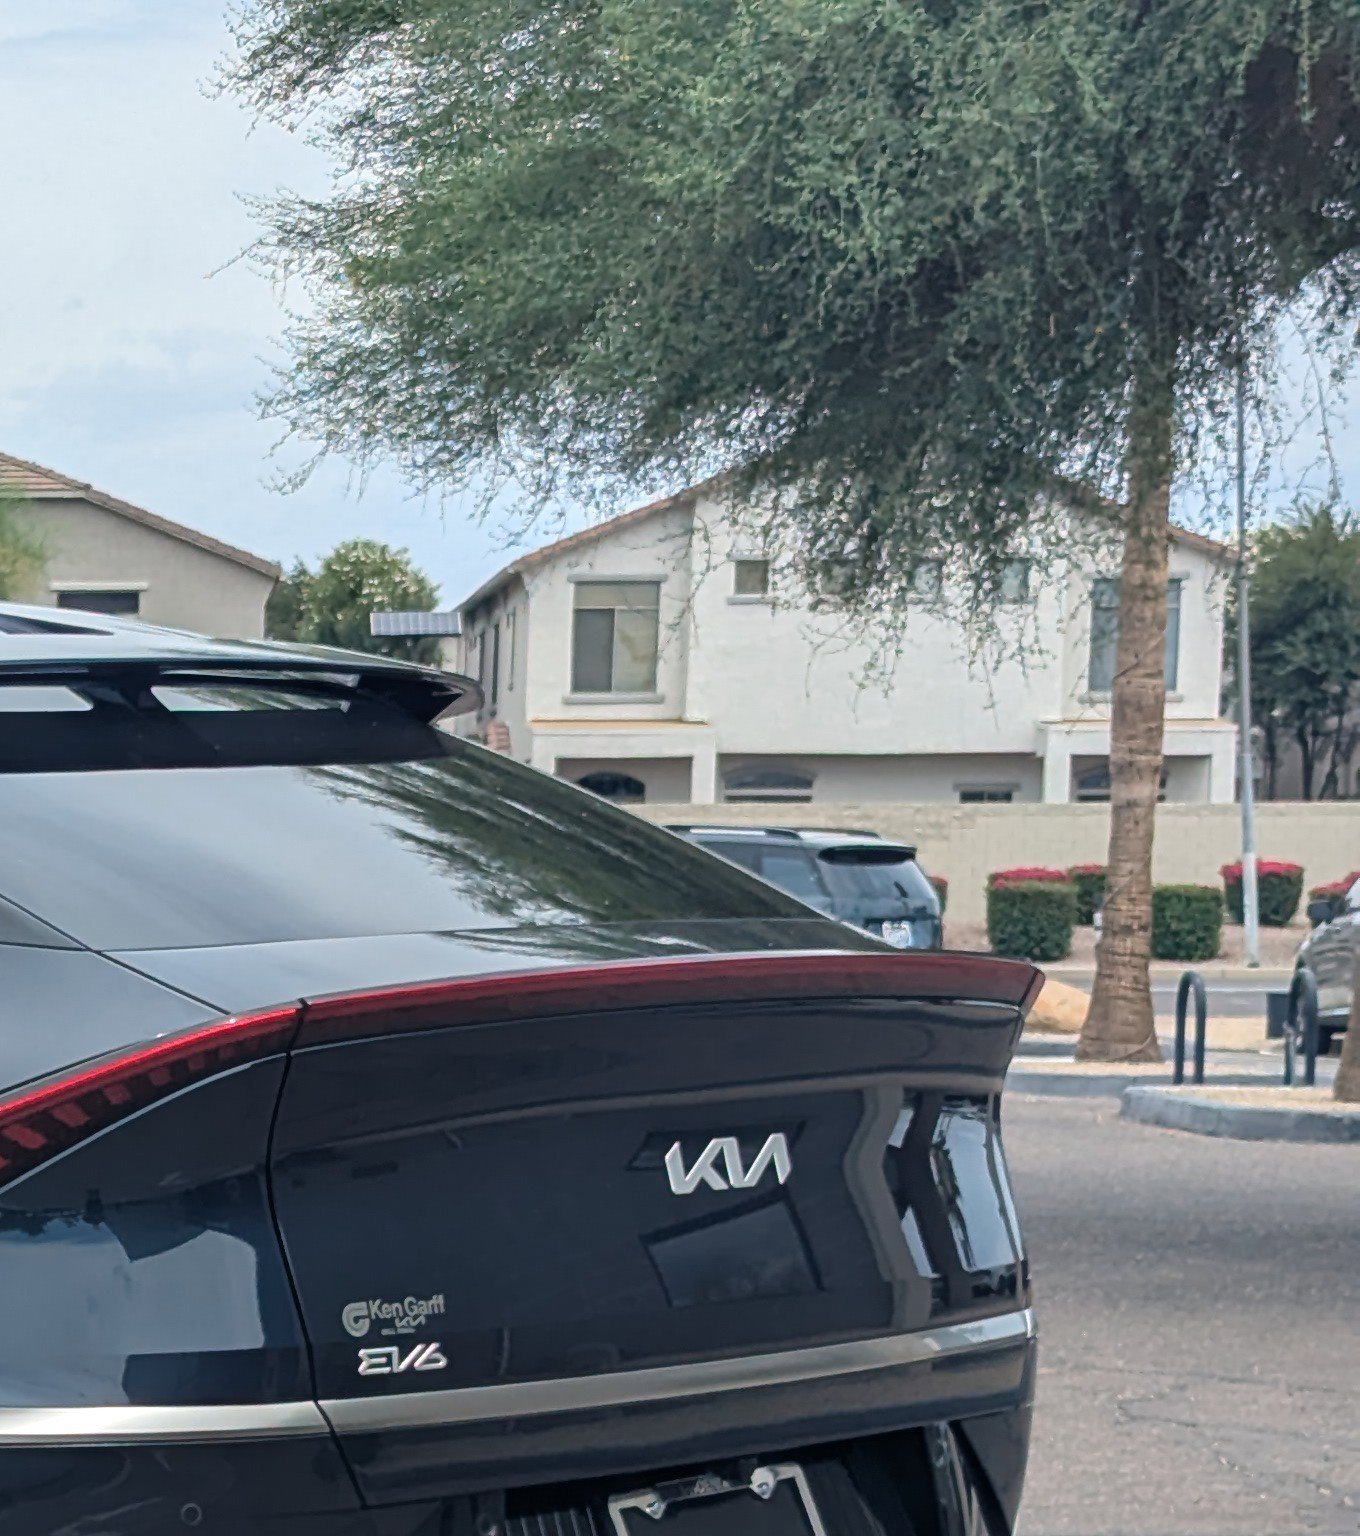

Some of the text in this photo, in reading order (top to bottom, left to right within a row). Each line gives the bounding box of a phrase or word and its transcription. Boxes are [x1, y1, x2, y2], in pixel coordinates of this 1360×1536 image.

[665, 1132, 792, 1195] KIA
[368, 1293, 446, 1320] Ken Garff
[358, 1342, 448, 1376] EV6
